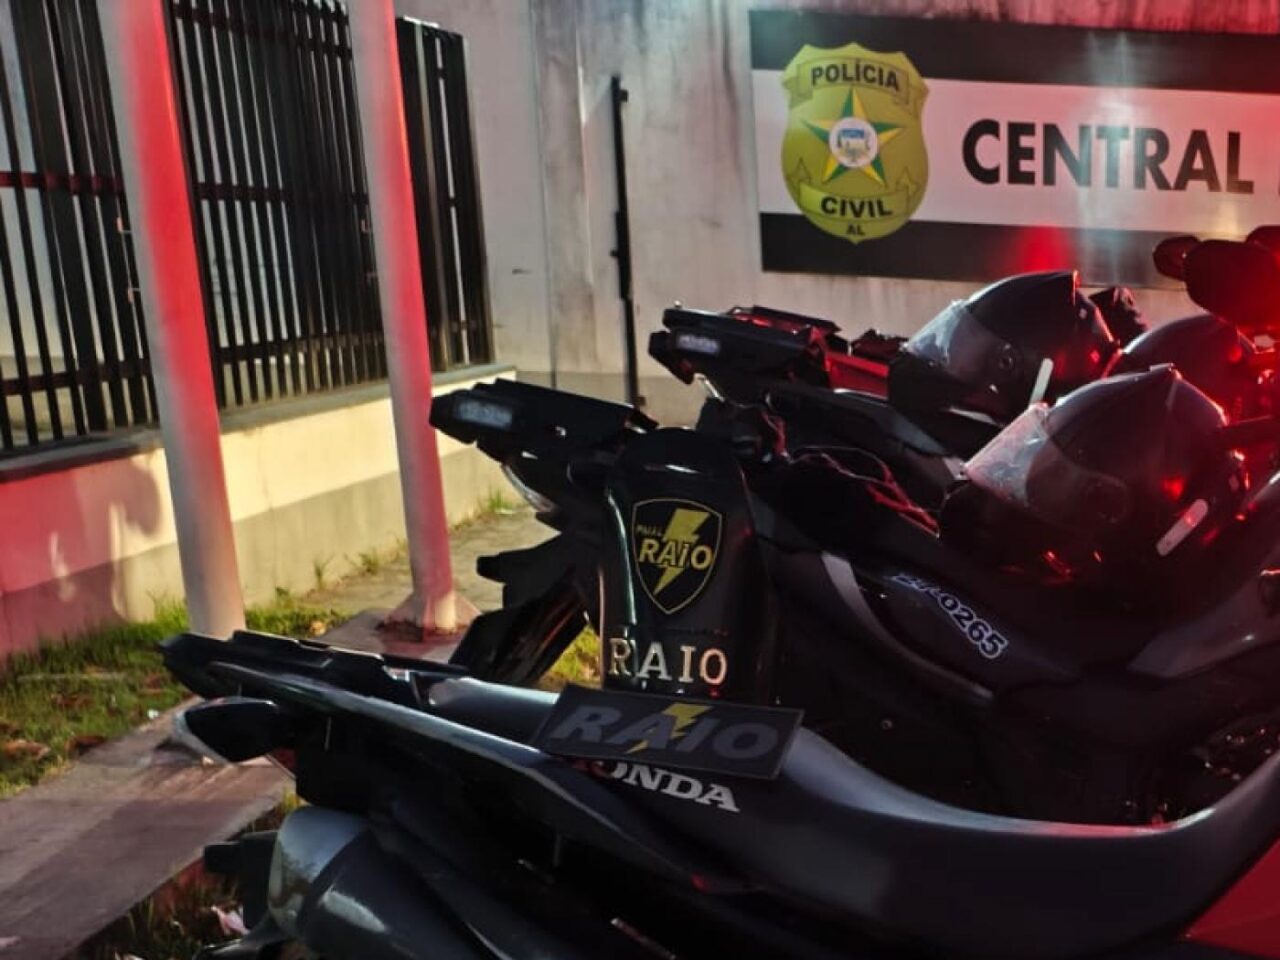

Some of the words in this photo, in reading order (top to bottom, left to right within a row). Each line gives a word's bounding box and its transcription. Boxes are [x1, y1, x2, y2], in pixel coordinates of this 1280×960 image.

[811, 58, 899, 92] POLÍCIA
[961, 117, 1254, 196] CENTRAL
[821, 196, 893, 218] CIVIL
[846, 224, 866, 236] AL
[639, 538, 714, 570] RAIO
[608, 637, 728, 685] RAIO
[550, 704, 780, 760] RAIO
[597, 759, 741, 814] ONDA
